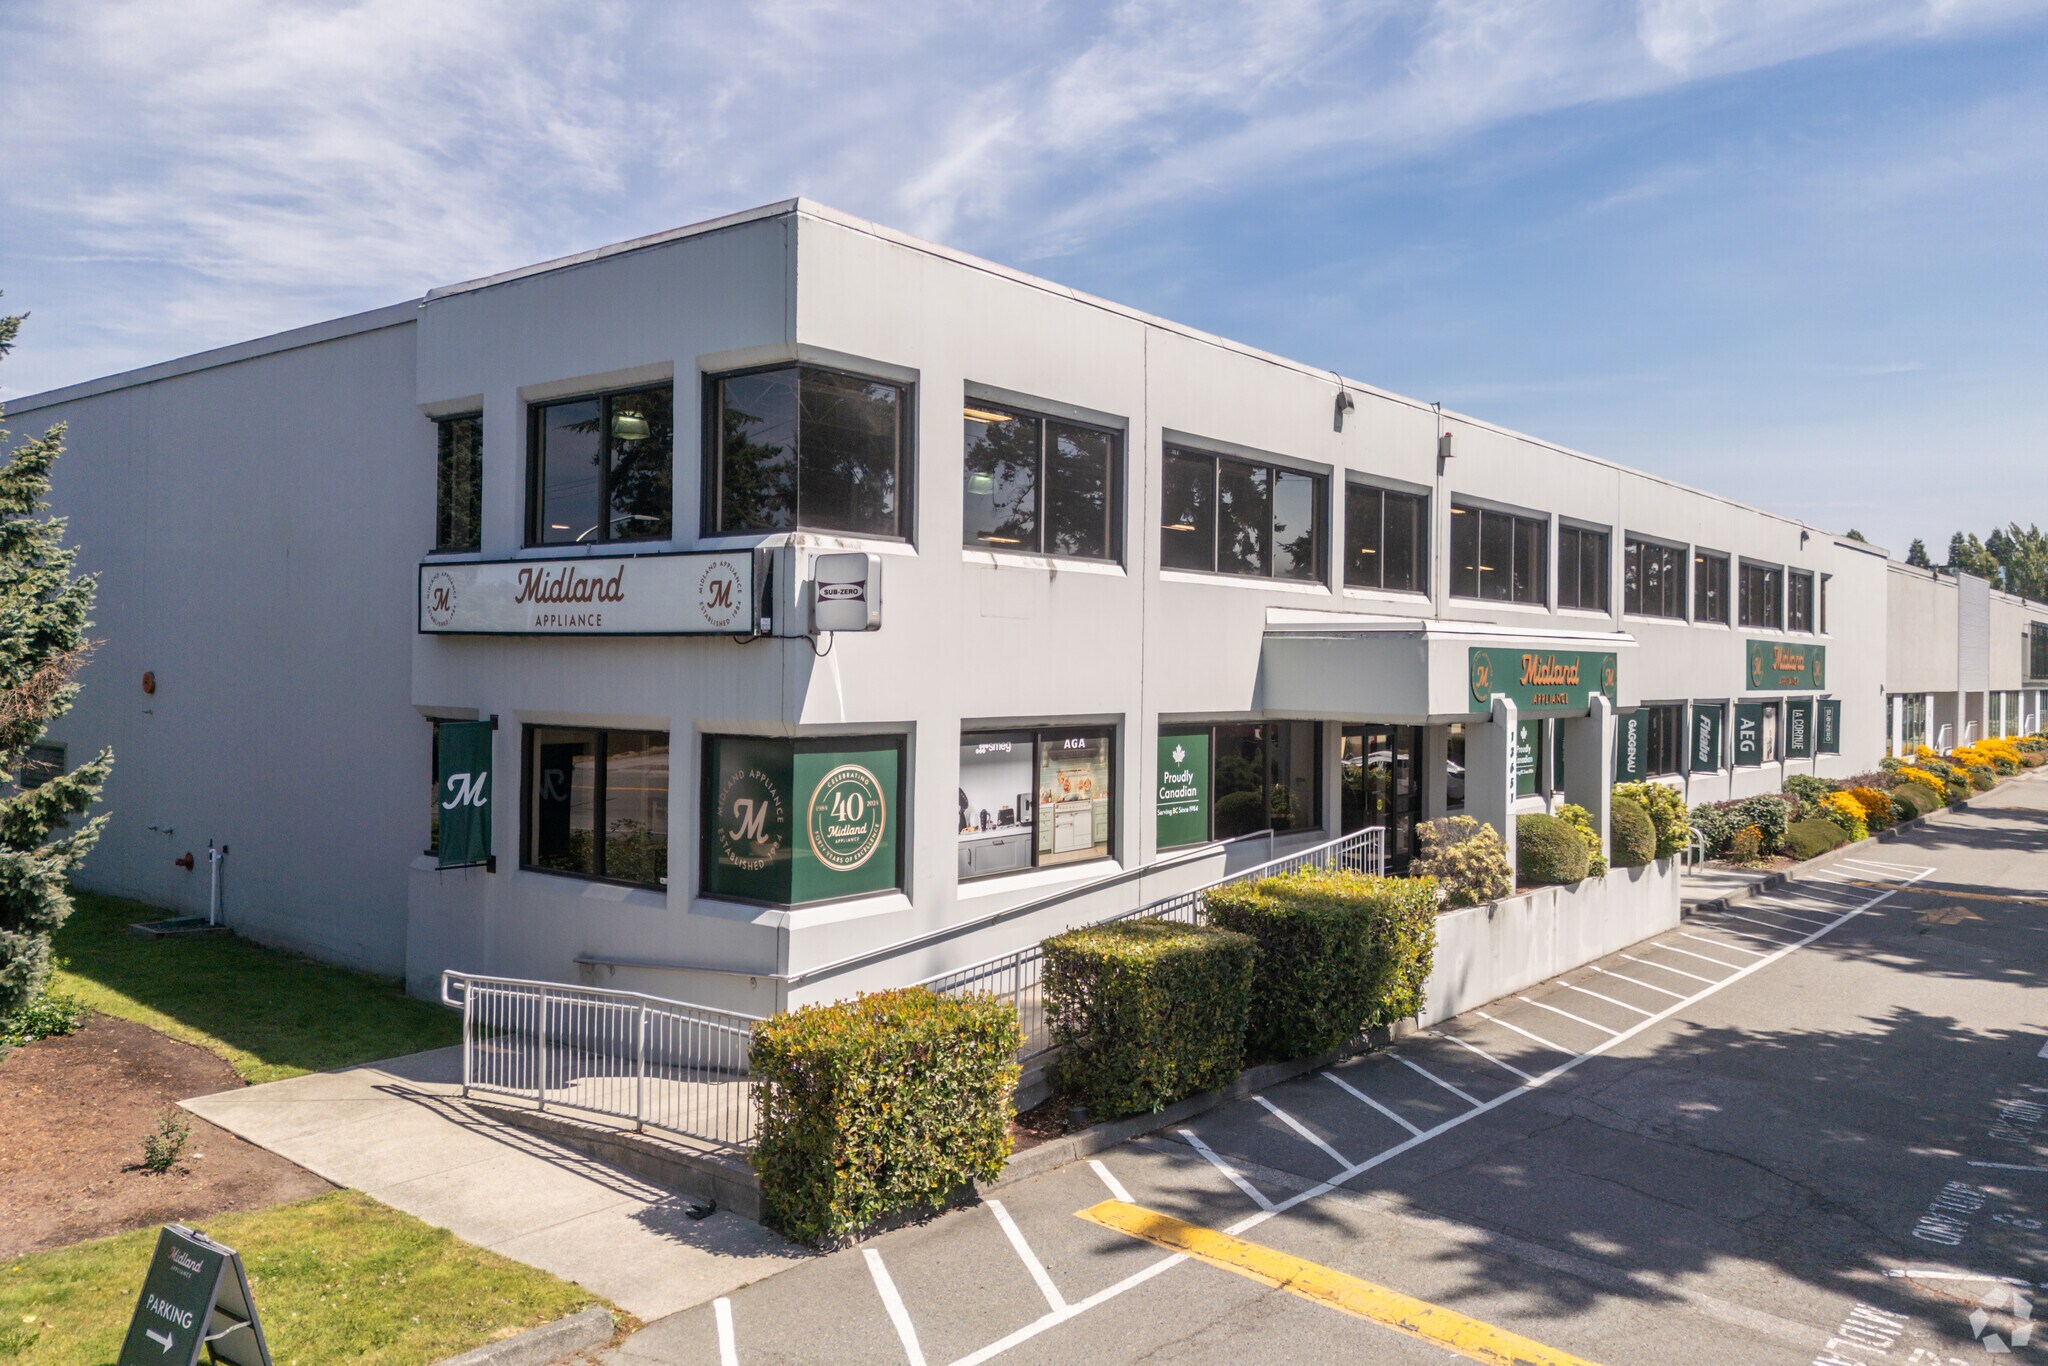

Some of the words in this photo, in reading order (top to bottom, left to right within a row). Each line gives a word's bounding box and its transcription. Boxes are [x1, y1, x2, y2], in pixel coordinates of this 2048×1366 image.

[515, 564, 624, 604] Midland
[699, 562, 717, 594] MIDLAND
[720, 561, 742, 593] APPLIANCE
[823, 588, 859, 596] SUB-ZERO
[432, 588, 450, 611] M
[707, 580, 732, 608] M
[535, 614, 602, 627] APPLIANCE
[699, 601, 730, 627] ESTABLISHED
[1475, 665, 1488, 687] M
[1520, 654, 1579, 686] Midland
[1532, 693, 1569, 705] APPLIANCE
[1063, 738, 1086, 749] AGA
[1627, 719, 1637, 773] GAGGENAU
[1699, 714, 1711, 763] Fhiaba
[1740, 718, 1755, 752] AEG
[1794, 718, 1804, 750] CORNUE
[442, 771, 487, 810] M
[827, 772, 870, 787] CELEBRATING
[1164, 769, 1193, 785] Proudly
[717, 770, 744, 816] MIDLAND
[749, 769, 784, 823] APPLIANCE
[831, 791, 864, 822] 40
[1159, 785, 1197, 799] Canadian
[729, 798, 769, 844] M
[827, 822, 867, 838] Midland
[717, 828, 765, 871] ESTABLISHED
[767, 834, 783, 860] 1984
[814, 830, 826, 852] FORTY
[826, 852, 843, 863] YEARS
[845, 855, 852, 863] OF
[854, 823, 880, 860] EXCELLENCE
[835, 836, 860, 844] APPLIANCE
[168, 1246, 204, 1273] Midland
[146, 1294, 193, 1329] PARKING
